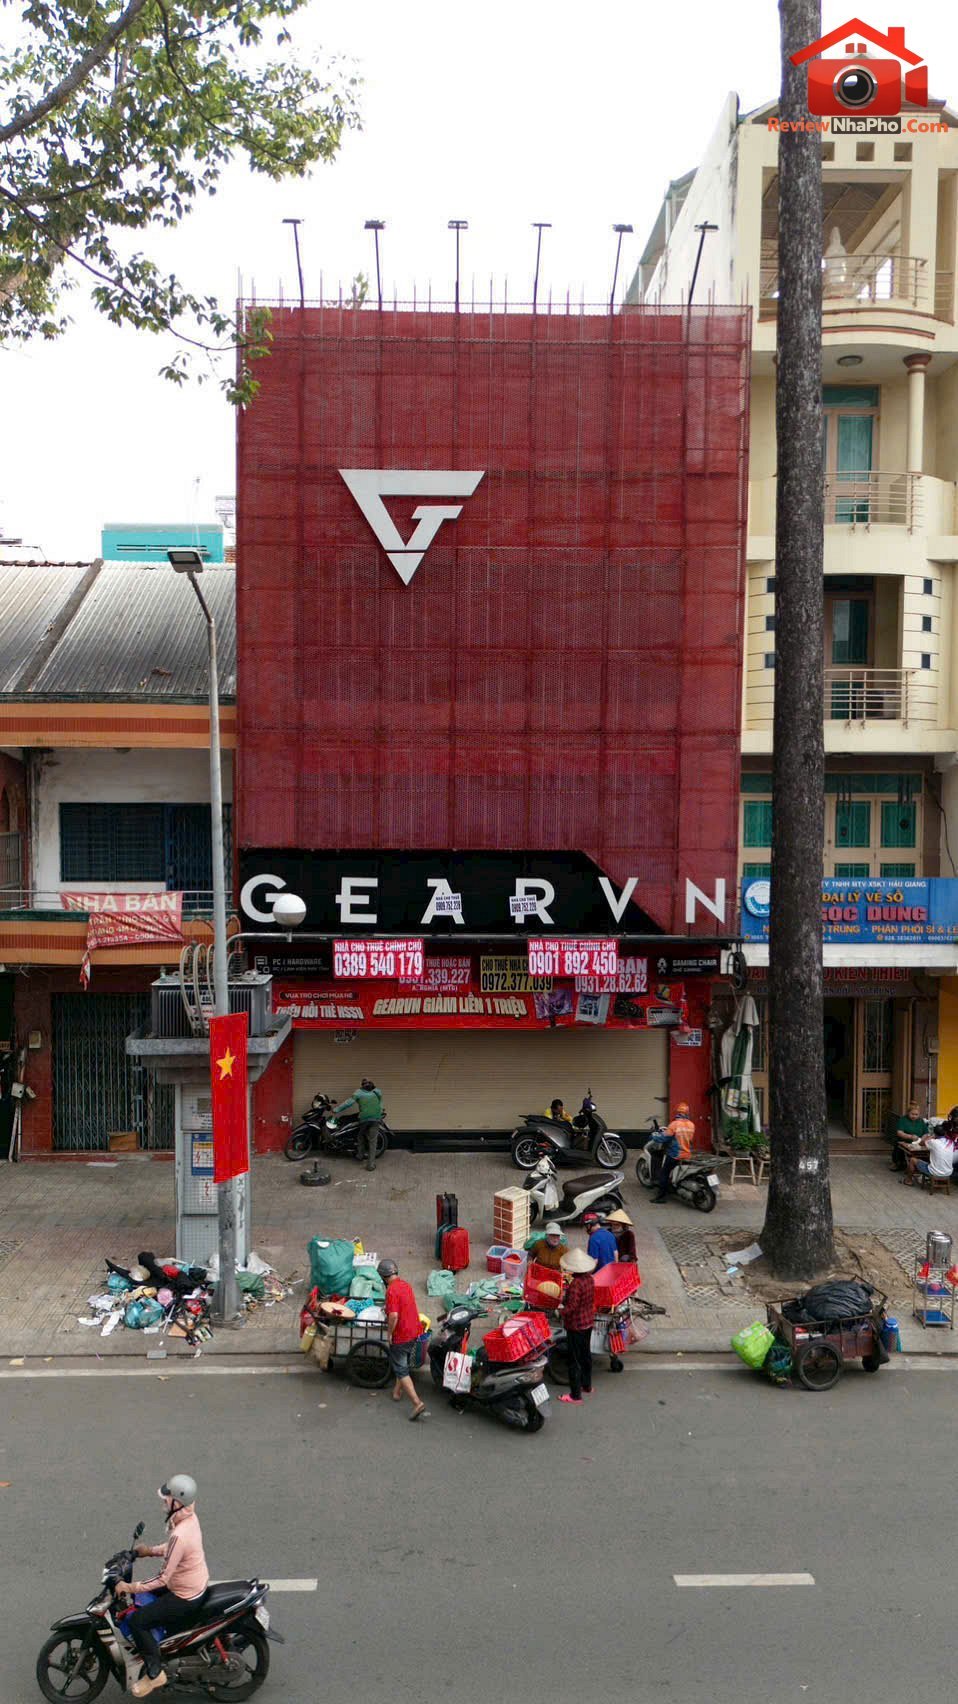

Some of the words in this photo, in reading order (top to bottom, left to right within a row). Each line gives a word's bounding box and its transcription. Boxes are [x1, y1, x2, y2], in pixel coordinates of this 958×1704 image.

[125, 891, 177, 912] BÁN
[240, 873, 726, 924] GEARVN
[822, 893, 845, 905] ĐẠI
[848, 890, 861, 902] LÝ
[335, 941, 349, 952] NHÀ
[351, 943, 365, 952] CHO
[367, 941, 384, 952] THUÊ
[385, 941, 407, 951] CHÍNH
[529, 940, 543, 950] NHÀ
[545, 941, 559, 950] CHO
[561, 940, 578, 950] THUÊ
[580, 940, 601, 951] CHÍNH
[334, 952, 366, 976] 0389
[370, 952, 395, 976] 540
[398, 951, 423, 976] 179
[482, 959, 494, 971] CHO
[529, 951, 559, 975] 0901
[565, 951, 589, 975] 892
[593, 951, 617, 975] 450
[617, 956, 647, 973] BÁN
[373, 998, 422, 1015] GEARVN
[423, 993, 457, 1013] GIẢM
[485, 999, 492, 1014] 1
[493, 996, 527, 1018] TRIỆU
